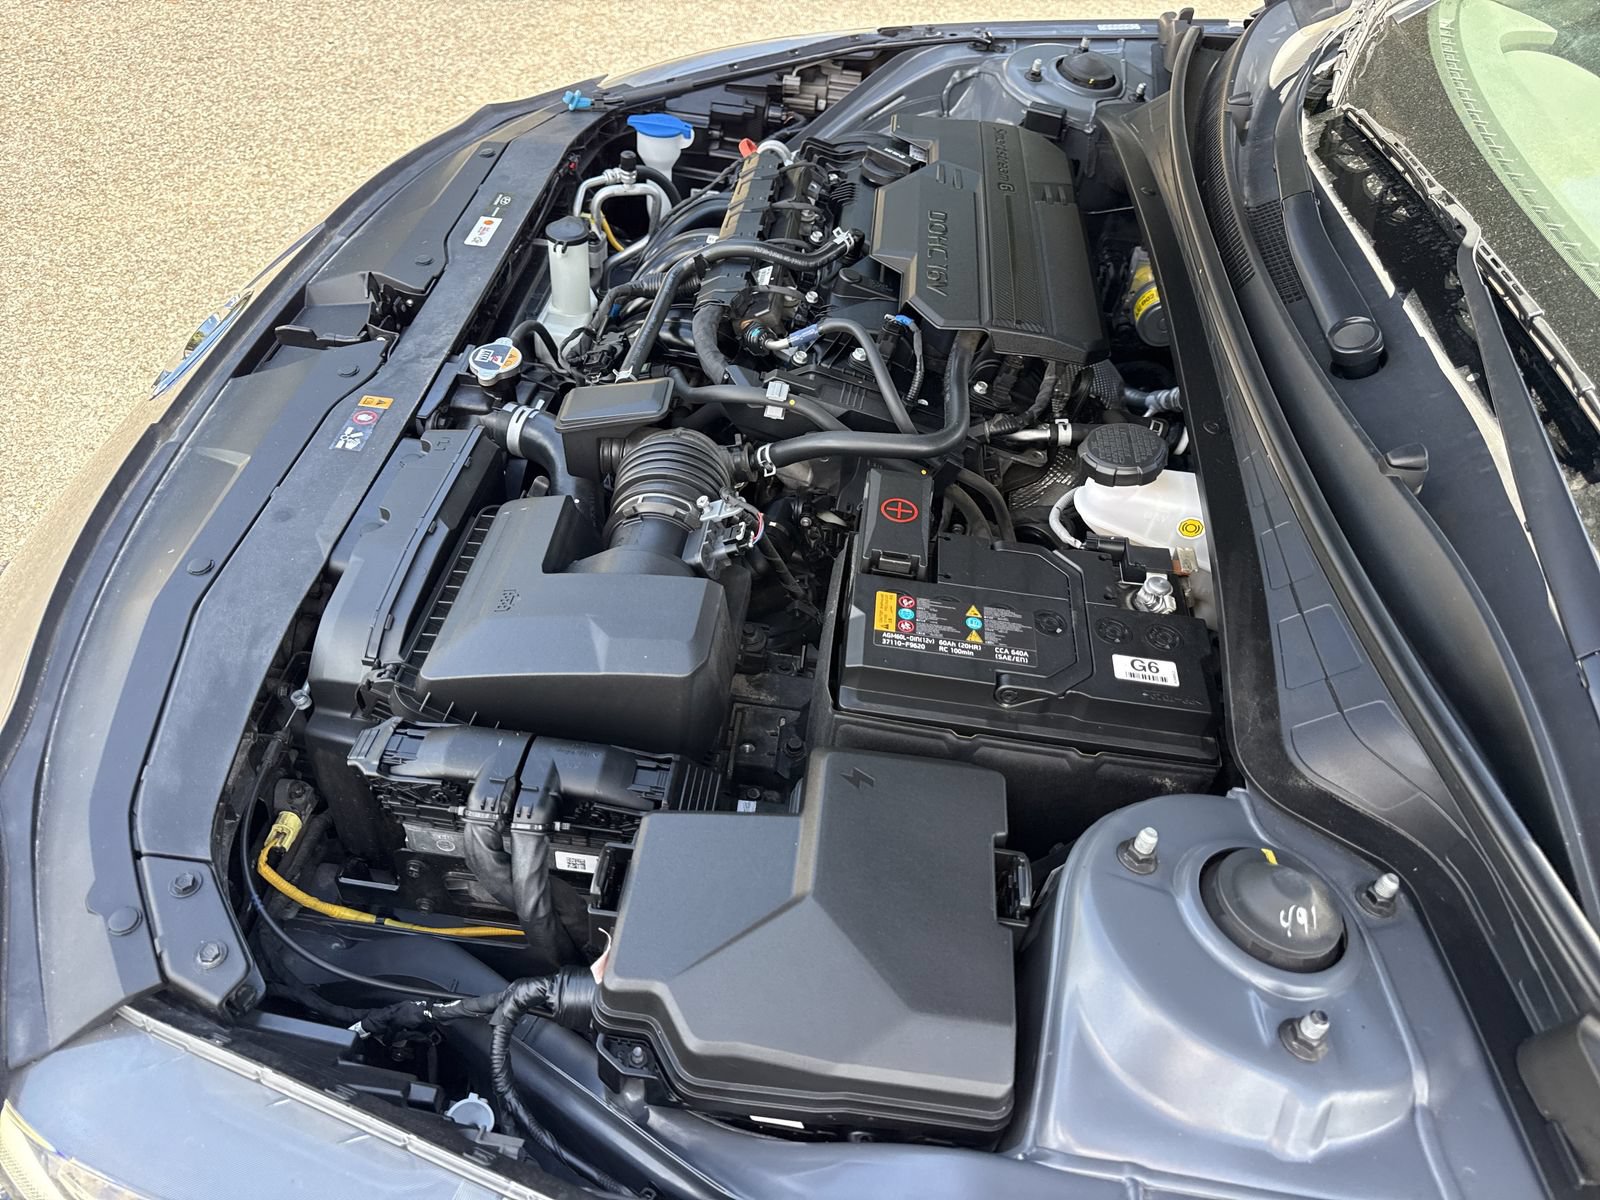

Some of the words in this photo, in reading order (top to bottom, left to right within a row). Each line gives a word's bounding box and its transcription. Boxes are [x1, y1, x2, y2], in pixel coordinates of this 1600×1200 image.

[999, 182, 1015, 194] G
[927, 209, 948, 263] DOHC
[927, 264, 948, 297] 16V
[938, 639, 957, 648] 60Ah
[957, 641, 982, 651] (20HR)
[994, 647, 1009, 655] CCA
[950, 647, 974, 656] 100min
[1130, 658, 1160, 674] G6
